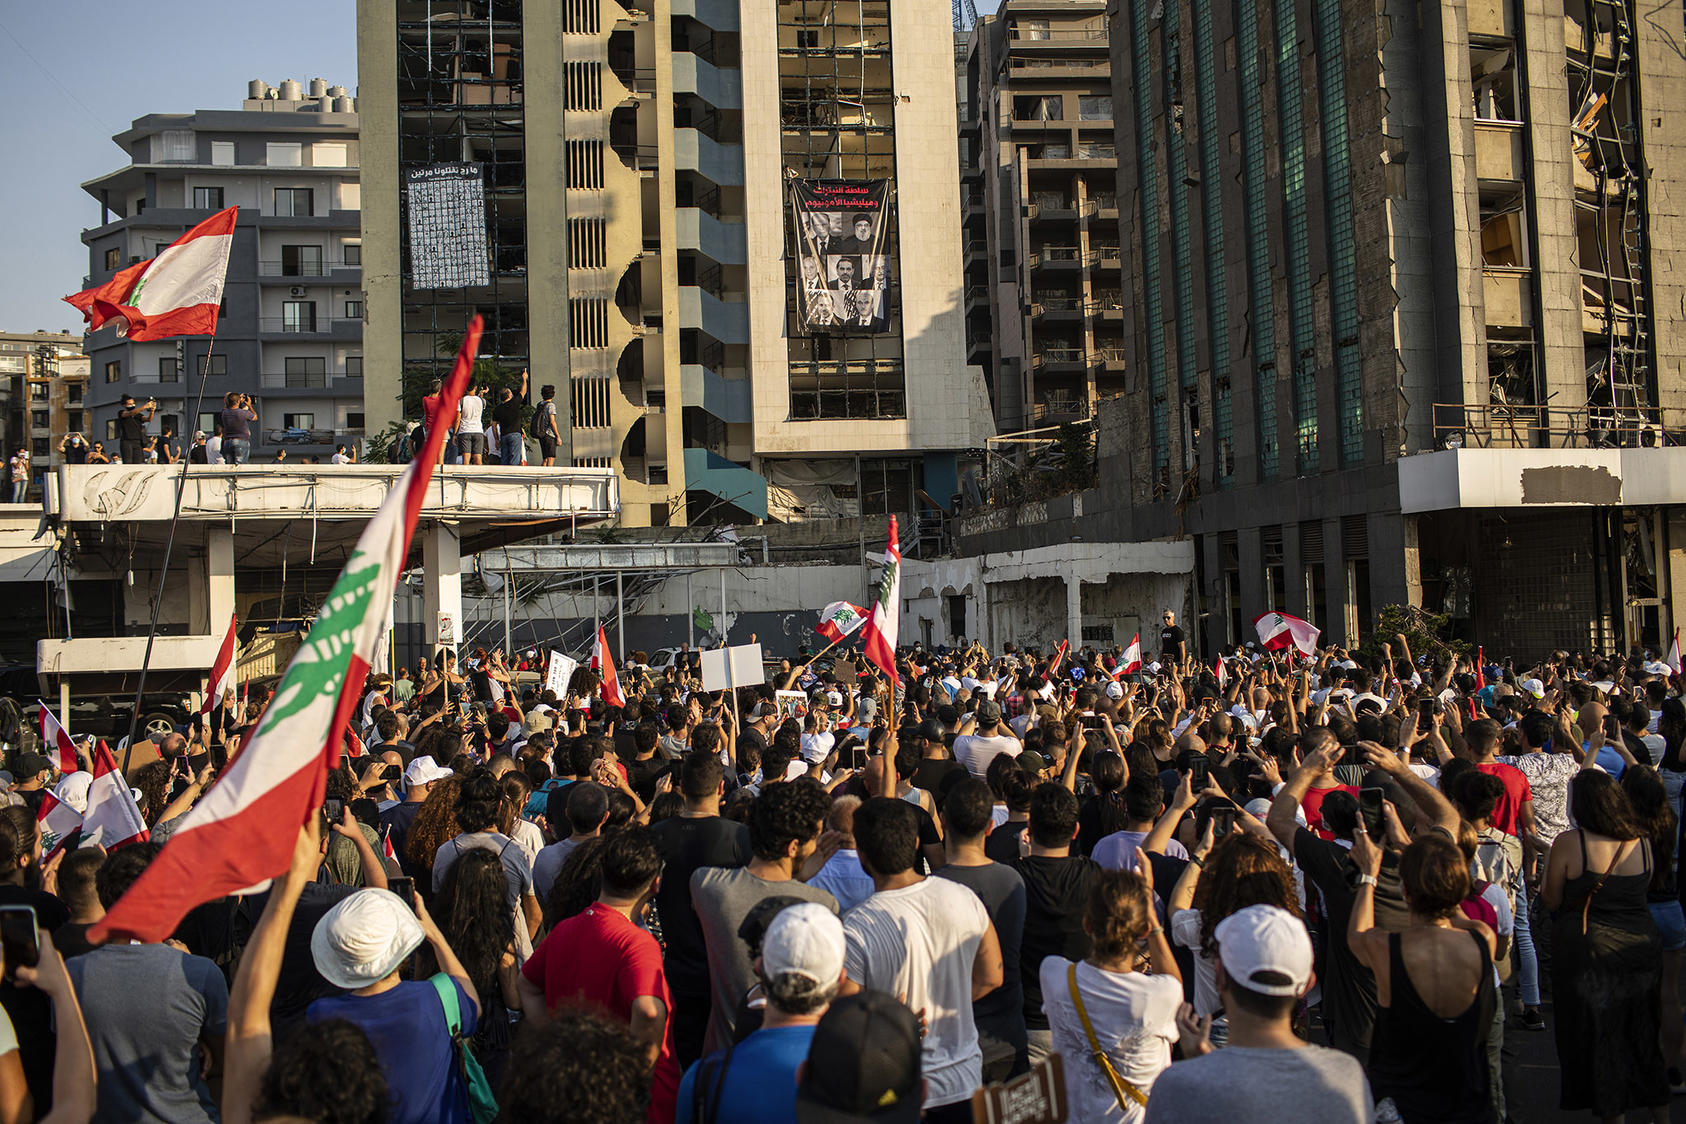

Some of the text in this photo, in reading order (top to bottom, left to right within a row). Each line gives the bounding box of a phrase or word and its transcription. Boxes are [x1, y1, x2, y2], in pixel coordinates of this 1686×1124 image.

[411, 169, 433, 179] مرتين
[434, 166, 459, 176] تقتلونا
[470, 166, 478, 174] ما
[845, 186, 869, 194] سلطة
[843, 197, 879, 208] وميليشيا
